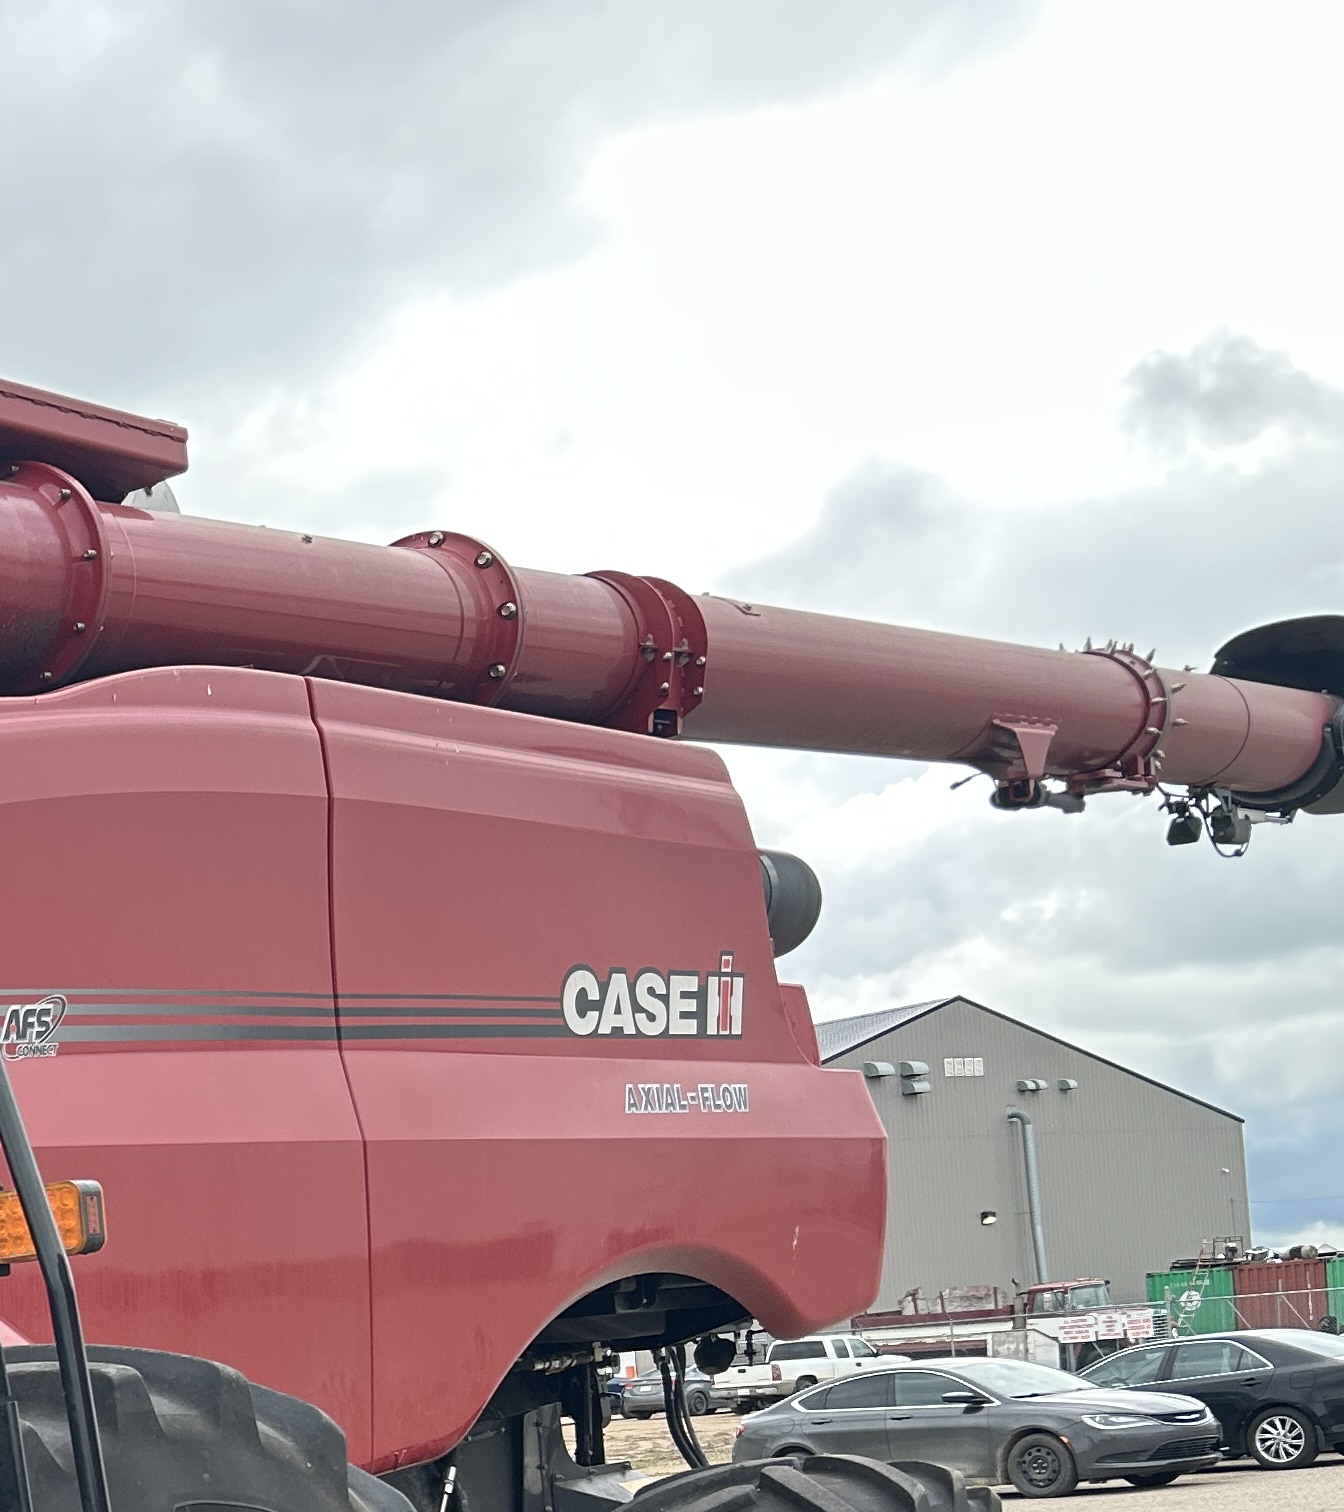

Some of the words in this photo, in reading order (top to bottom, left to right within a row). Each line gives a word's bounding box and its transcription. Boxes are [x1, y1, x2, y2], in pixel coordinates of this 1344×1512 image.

[562, 968, 700, 1036] CASE
[0, 1004, 54, 1044] AFS
[16, 1043, 59, 1057] CONNECT
[625, 1083, 750, 1114] AXIAL-FLOW
